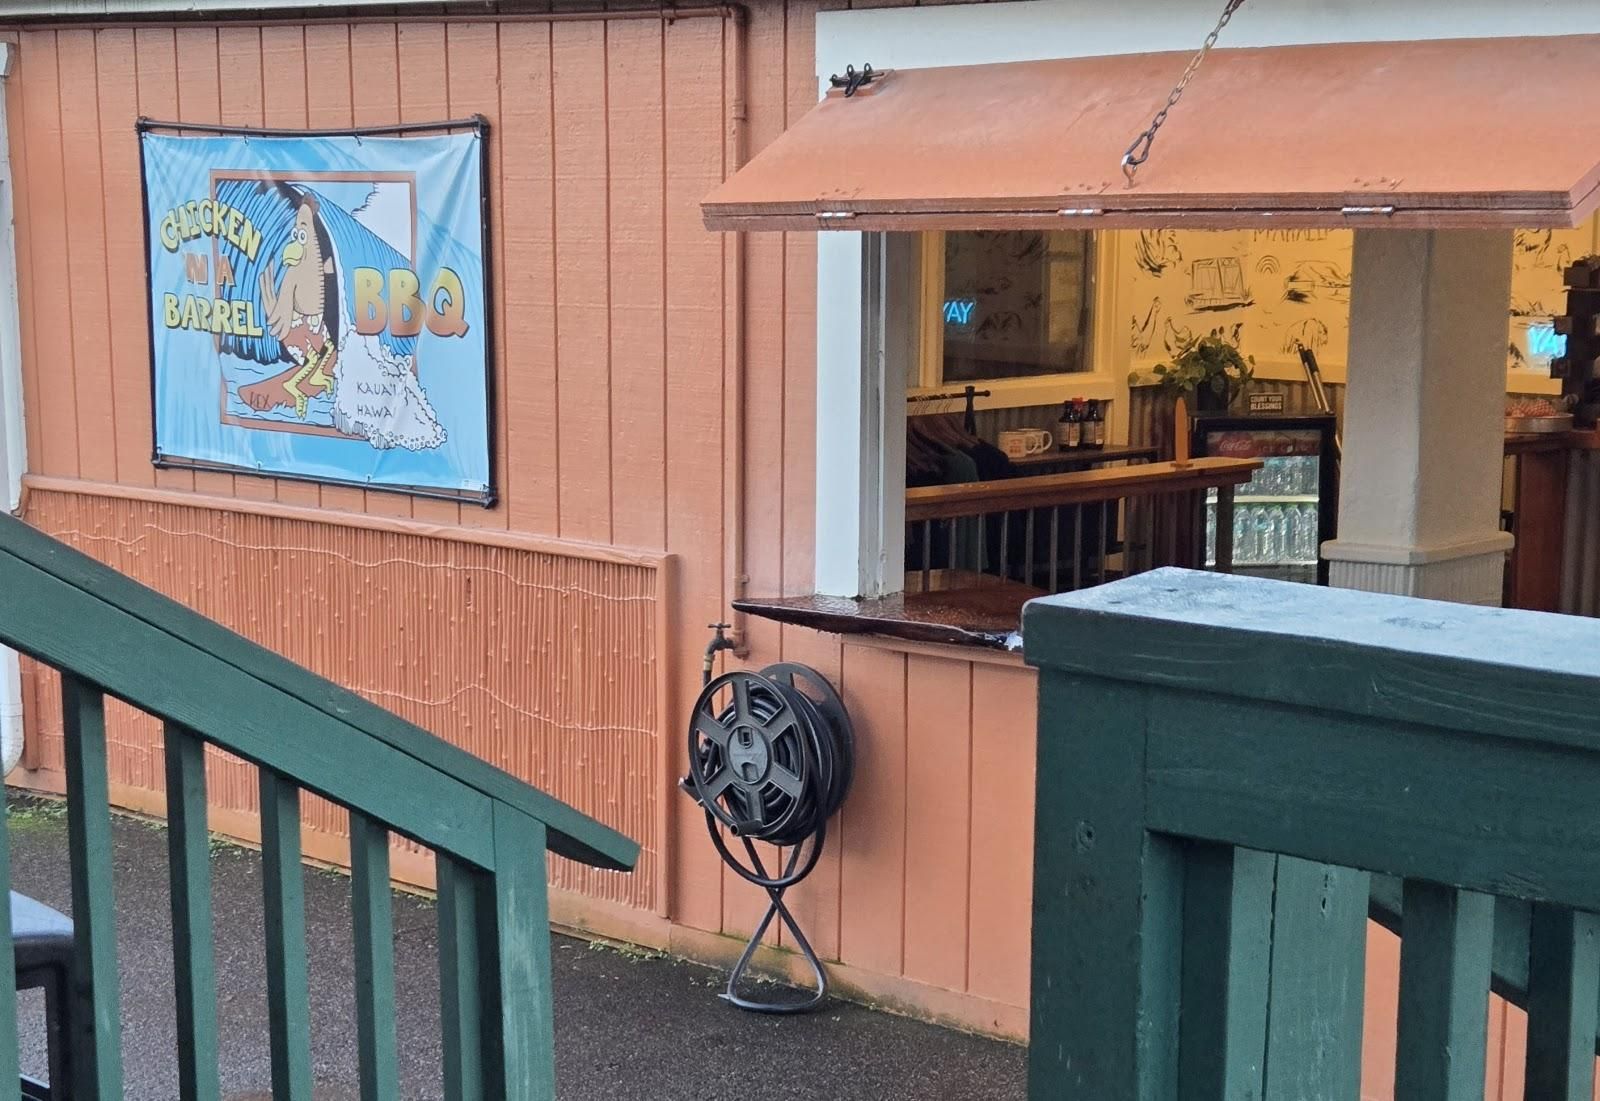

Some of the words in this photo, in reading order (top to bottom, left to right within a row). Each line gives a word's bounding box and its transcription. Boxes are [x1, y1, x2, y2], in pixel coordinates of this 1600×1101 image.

[160, 198, 263, 265] CHICKEN
[216, 253, 236, 287] A
[163, 291, 264, 337] BARREL
[353, 266, 470, 338] BBQ
